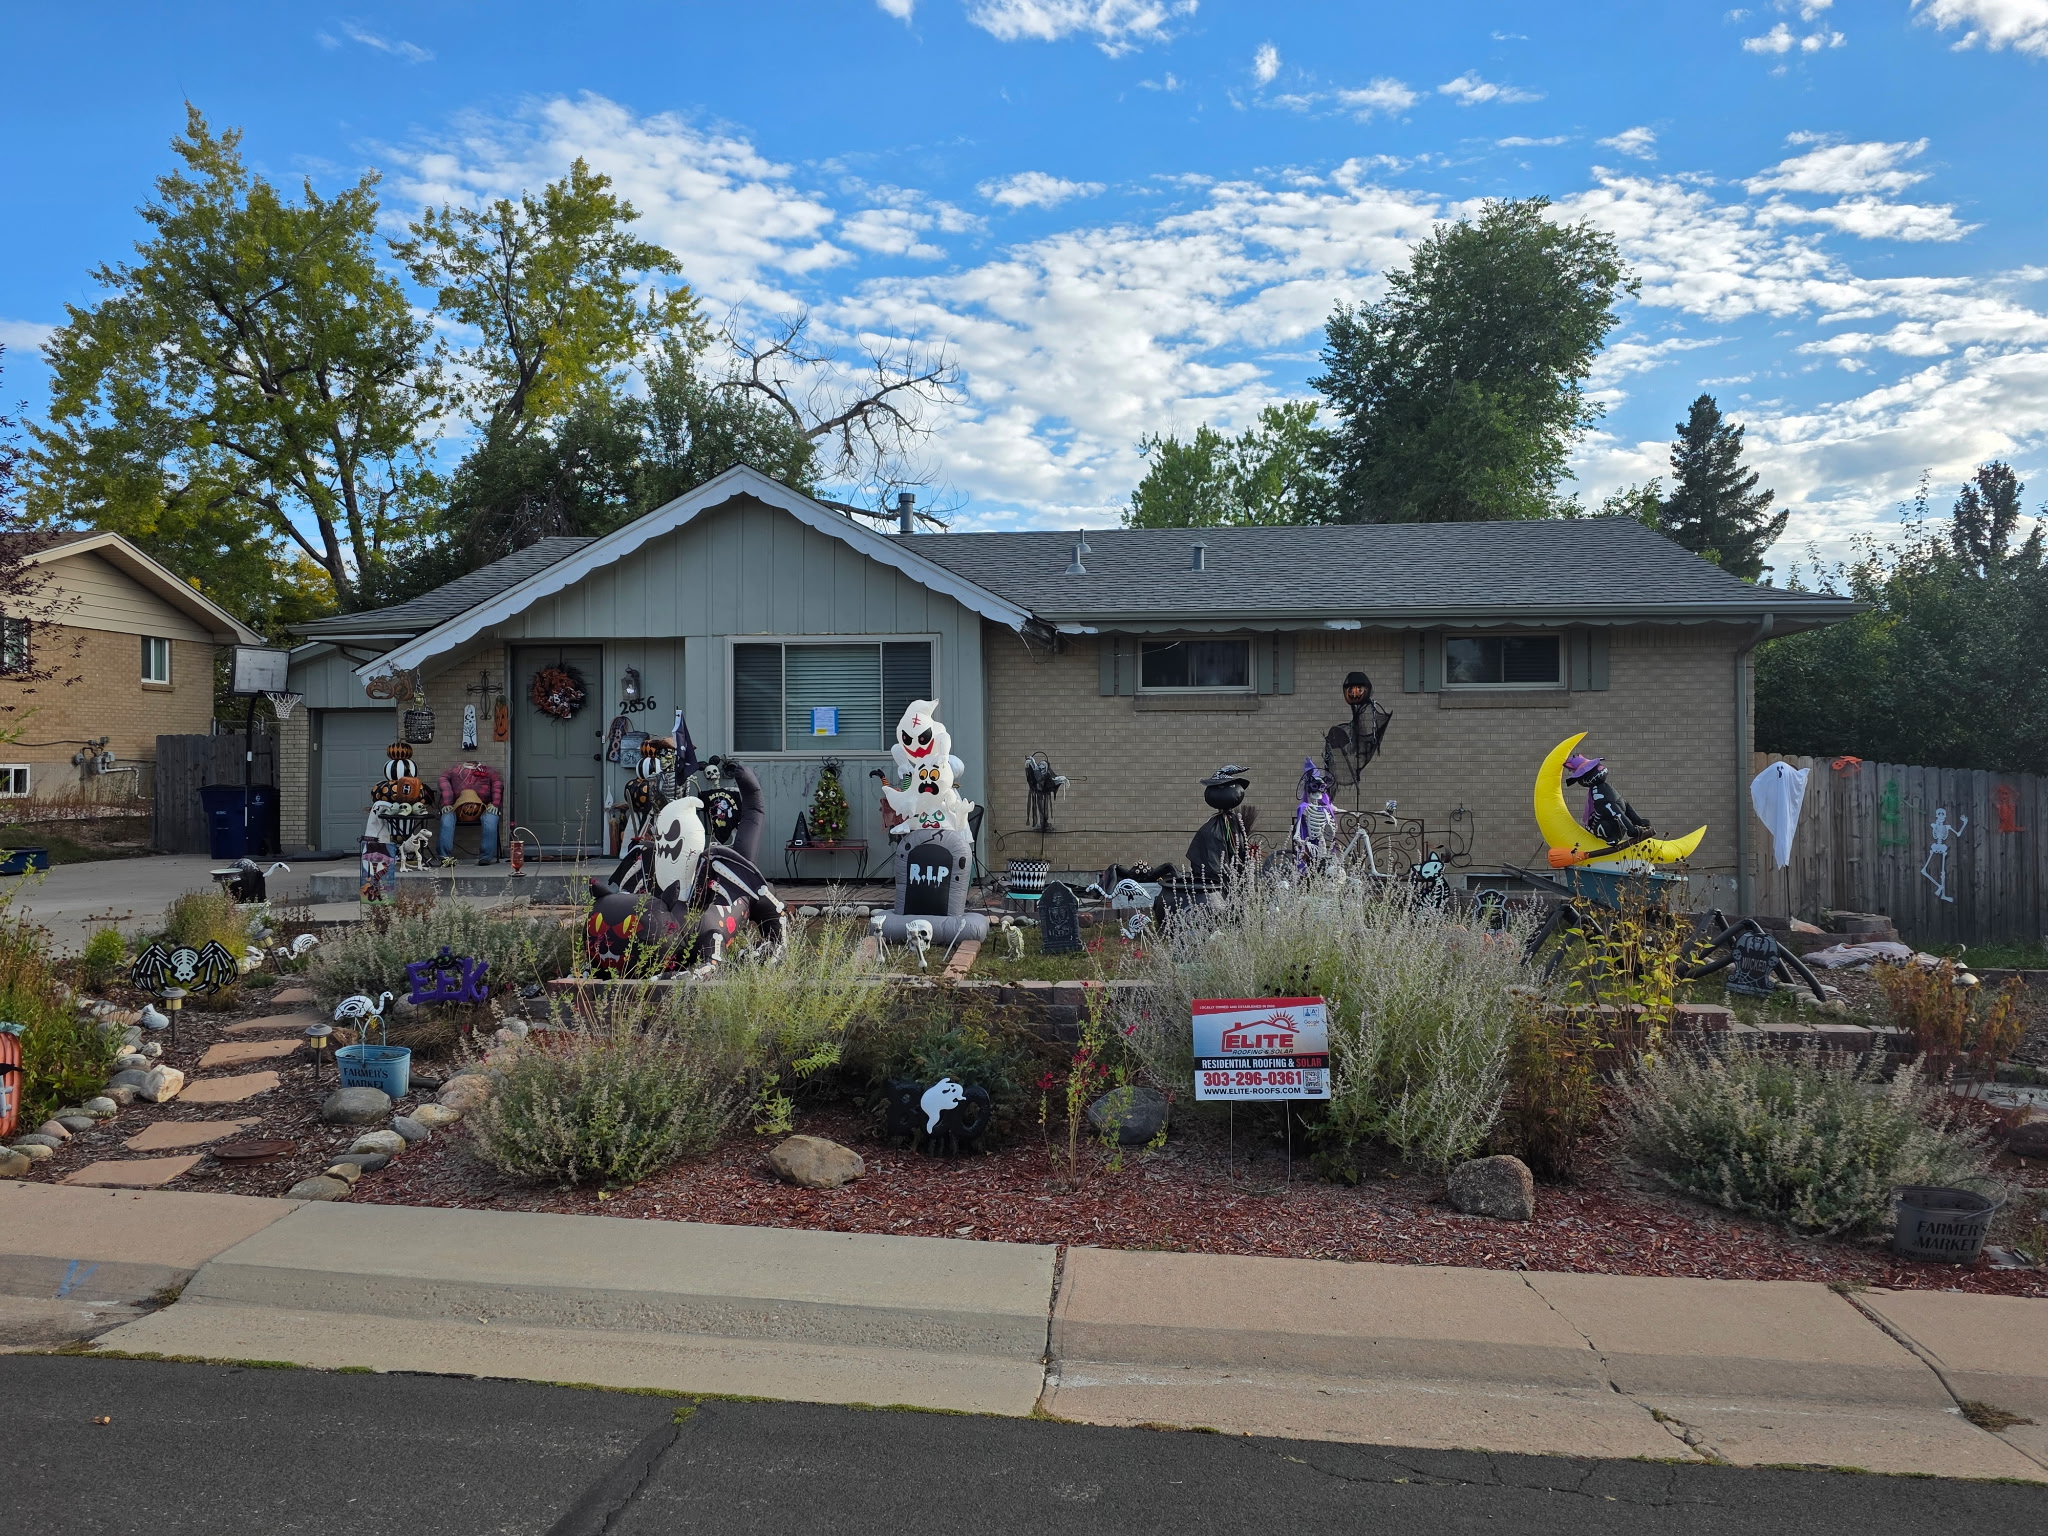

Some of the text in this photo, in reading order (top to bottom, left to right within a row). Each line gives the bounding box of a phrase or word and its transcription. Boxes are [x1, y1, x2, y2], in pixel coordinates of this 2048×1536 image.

[619, 696, 657, 715] 2856
[1741, 957, 1767, 972] WICKED
[405, 956, 489, 1005] EEK
[1226, 1034, 1293, 1048] ELITE
[1202, 1057, 1322, 1069] RESIDENTIAL ROOFING & SOLAR
[343, 1067, 389, 1079] FARMER'S
[1203, 1071, 1302, 1086] 303-296-0361
[347, 1079, 385, 1089] MARKET
[1204, 1087, 1301, 1095] WWW.ELITE-ROOFS.COM
[1917, 1221, 1989, 1237] FARMER'S
[1919, 1237, 1979, 1251] MARKET
